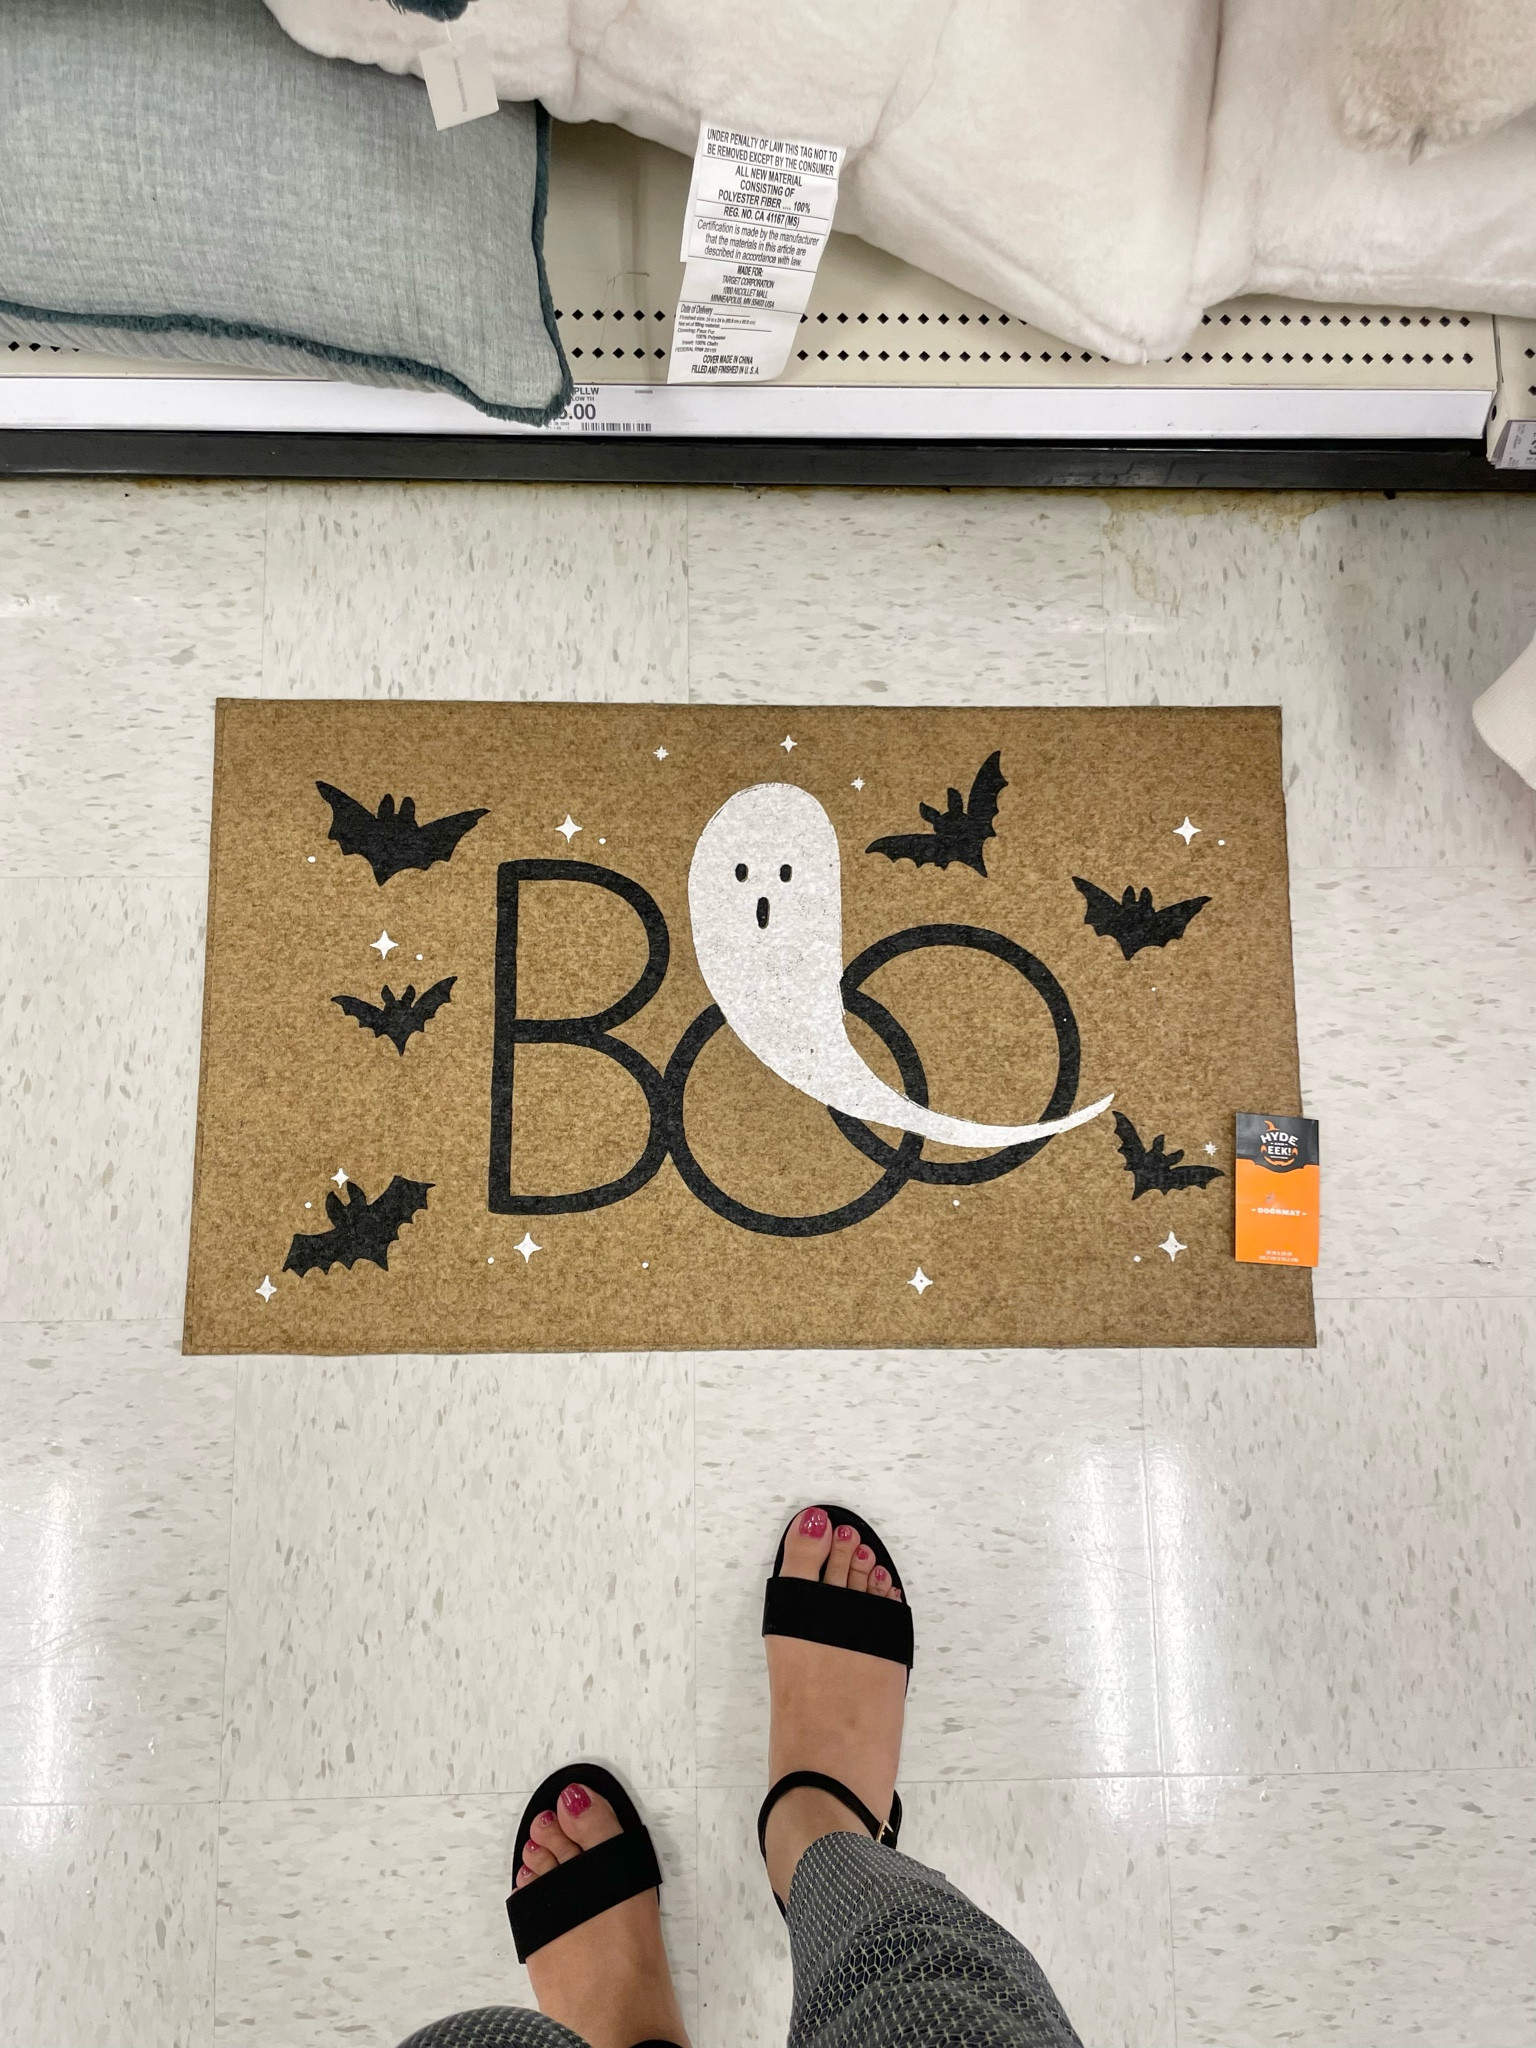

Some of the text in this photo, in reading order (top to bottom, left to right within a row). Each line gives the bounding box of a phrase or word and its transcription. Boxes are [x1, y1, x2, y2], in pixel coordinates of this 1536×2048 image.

[707, 128, 838, 162] UNDER PENALTY OF LAW THIS TAG NOT TO
[707, 143, 834, 176] BE REMOVED EXCEPT BY THE CONSUMER
[735, 165, 802, 187] ALL NEW MATERIAL
[740, 180, 795, 198] CONSISTING OF
[718, 189, 759, 206] POLYESTER
[760, 195, 781, 209] FIBER
[793, 201, 811, 214] 100%
[724, 206, 800, 229] REG. NO. CA 41167 (MS)
[697, 219, 820, 246] Certification is made by the manufacturer
[705, 233, 806, 256] that the materials in this article are
[704, 245, 802, 267] described in accordance with law.
[737, 265, 763, 277] MADE FOR:
[722, 275, 775, 289] TARGET CORPORATION
[733, 287, 756, 297] NICOLLET
[756, 289, 768, 299] MALL
[680, 304, 713, 316] Date of Delivery
[765, 300, 775, 308] USA
[702, 354, 753, 365] COVER MADE IN CHINA
[691, 364, 708, 374] FILLED
[707, 365, 718, 374] AND
[718, 365, 739, 374] FINISHED
[738, 366, 744, 375] IN
[489, 859, 1081, 1237] BOO
[1260, 1131, 1299, 1147] HYDE
[1267, 1145, 1292, 1156] EEK!
[1257, 1207, 1301, 1216] DOORMAT
